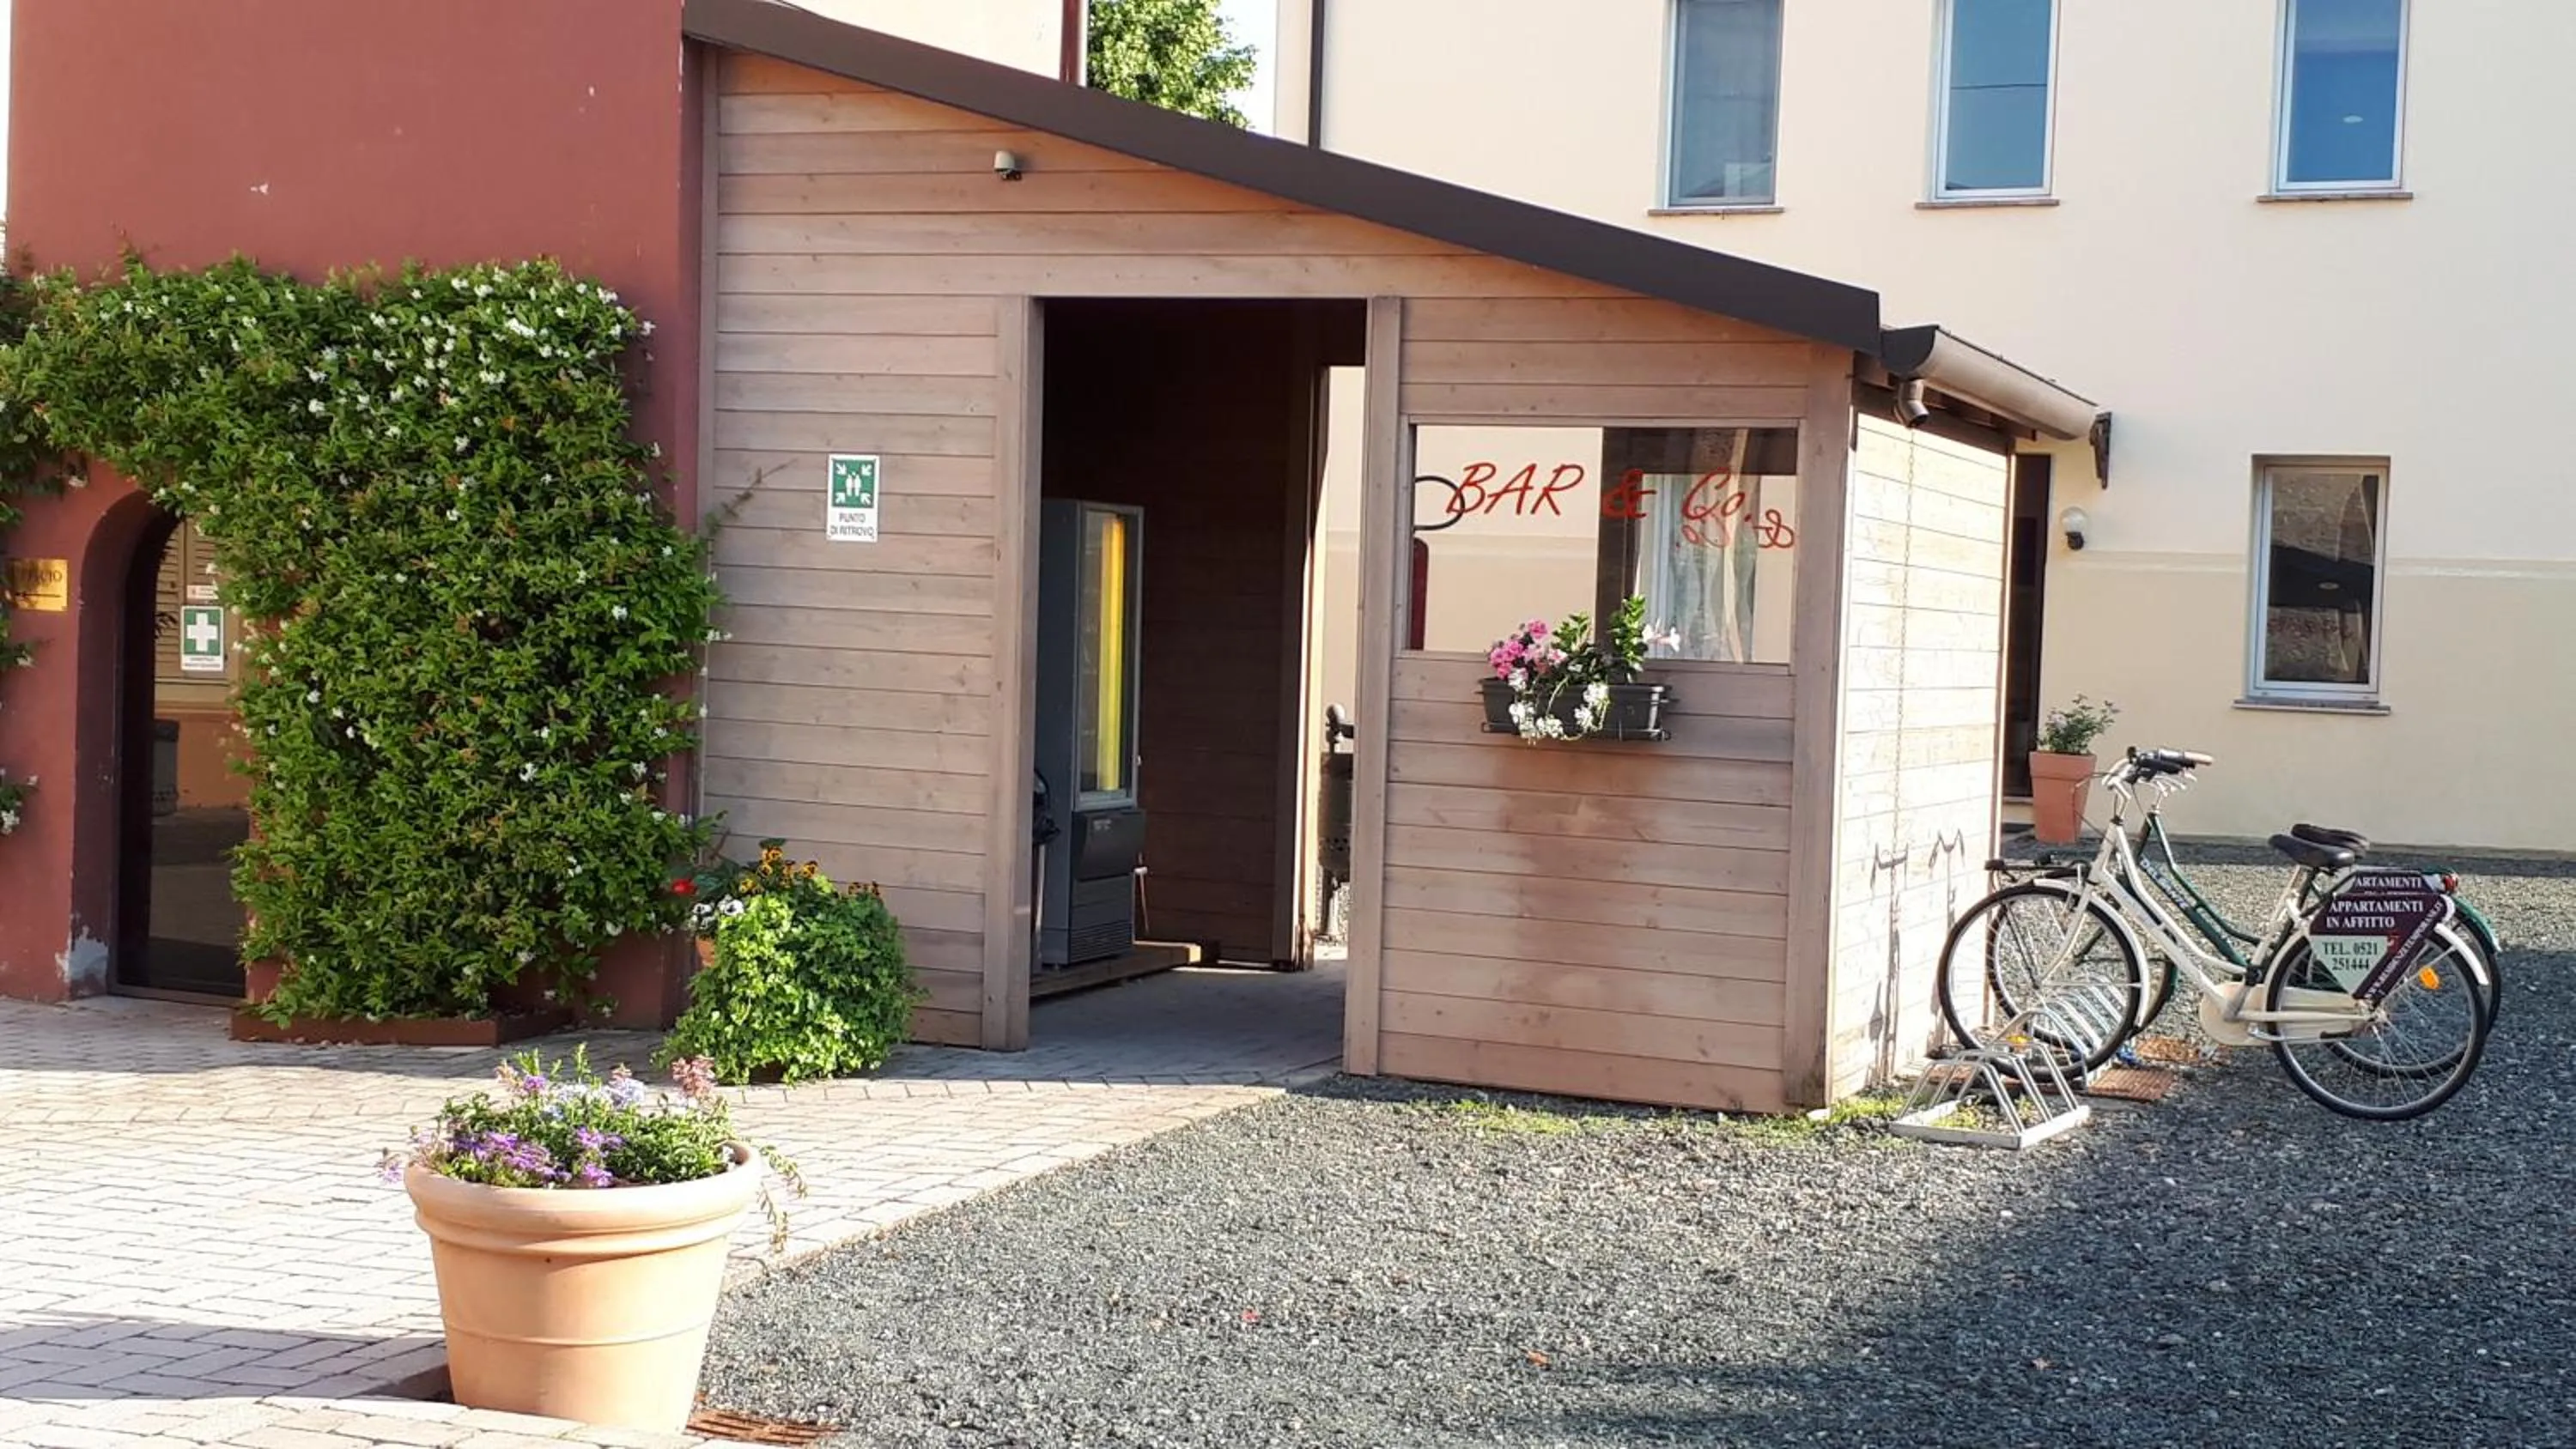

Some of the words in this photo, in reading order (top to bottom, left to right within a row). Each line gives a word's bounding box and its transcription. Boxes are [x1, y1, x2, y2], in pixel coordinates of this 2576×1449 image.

[1445, 462, 1585, 517] BAR
[1602, 469, 1657, 520] &
[838, 512, 866, 523] PUNTO
[2328, 900, 2424, 912] APPARTAMENTI
[2326, 916, 2340, 929] IN
[2342, 916, 2396, 929] AFFITTO
[2322, 942, 2351, 955] TEL.
[2354, 942, 2378, 955] 0521
[2331, 957, 2370, 972] 251444
